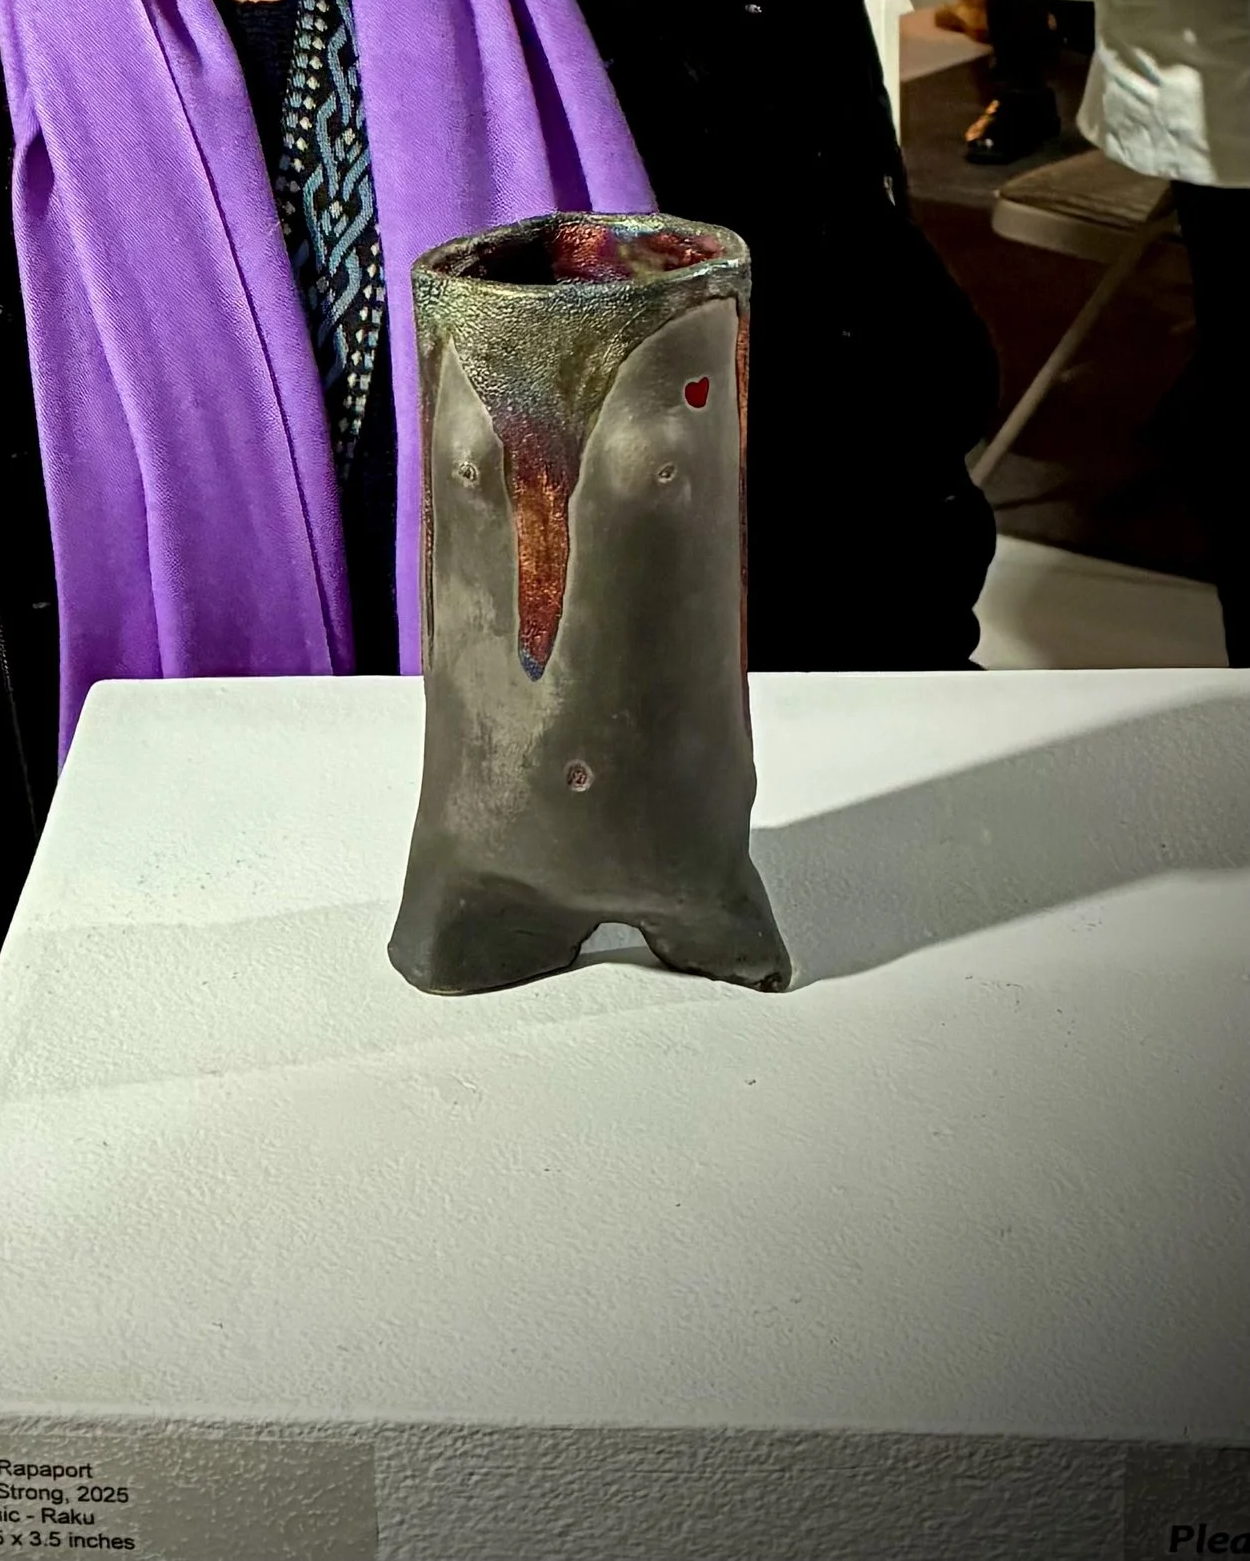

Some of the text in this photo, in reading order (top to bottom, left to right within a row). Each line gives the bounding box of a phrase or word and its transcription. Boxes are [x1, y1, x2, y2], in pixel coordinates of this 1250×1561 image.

[76, 1485, 130, 1504] 2025
[41, 1506, 96, 1525] Raku
[11, 1532, 24, 1547] x
[29, 1530, 62, 1548] 3.5
[68, 1531, 137, 1551] inches
